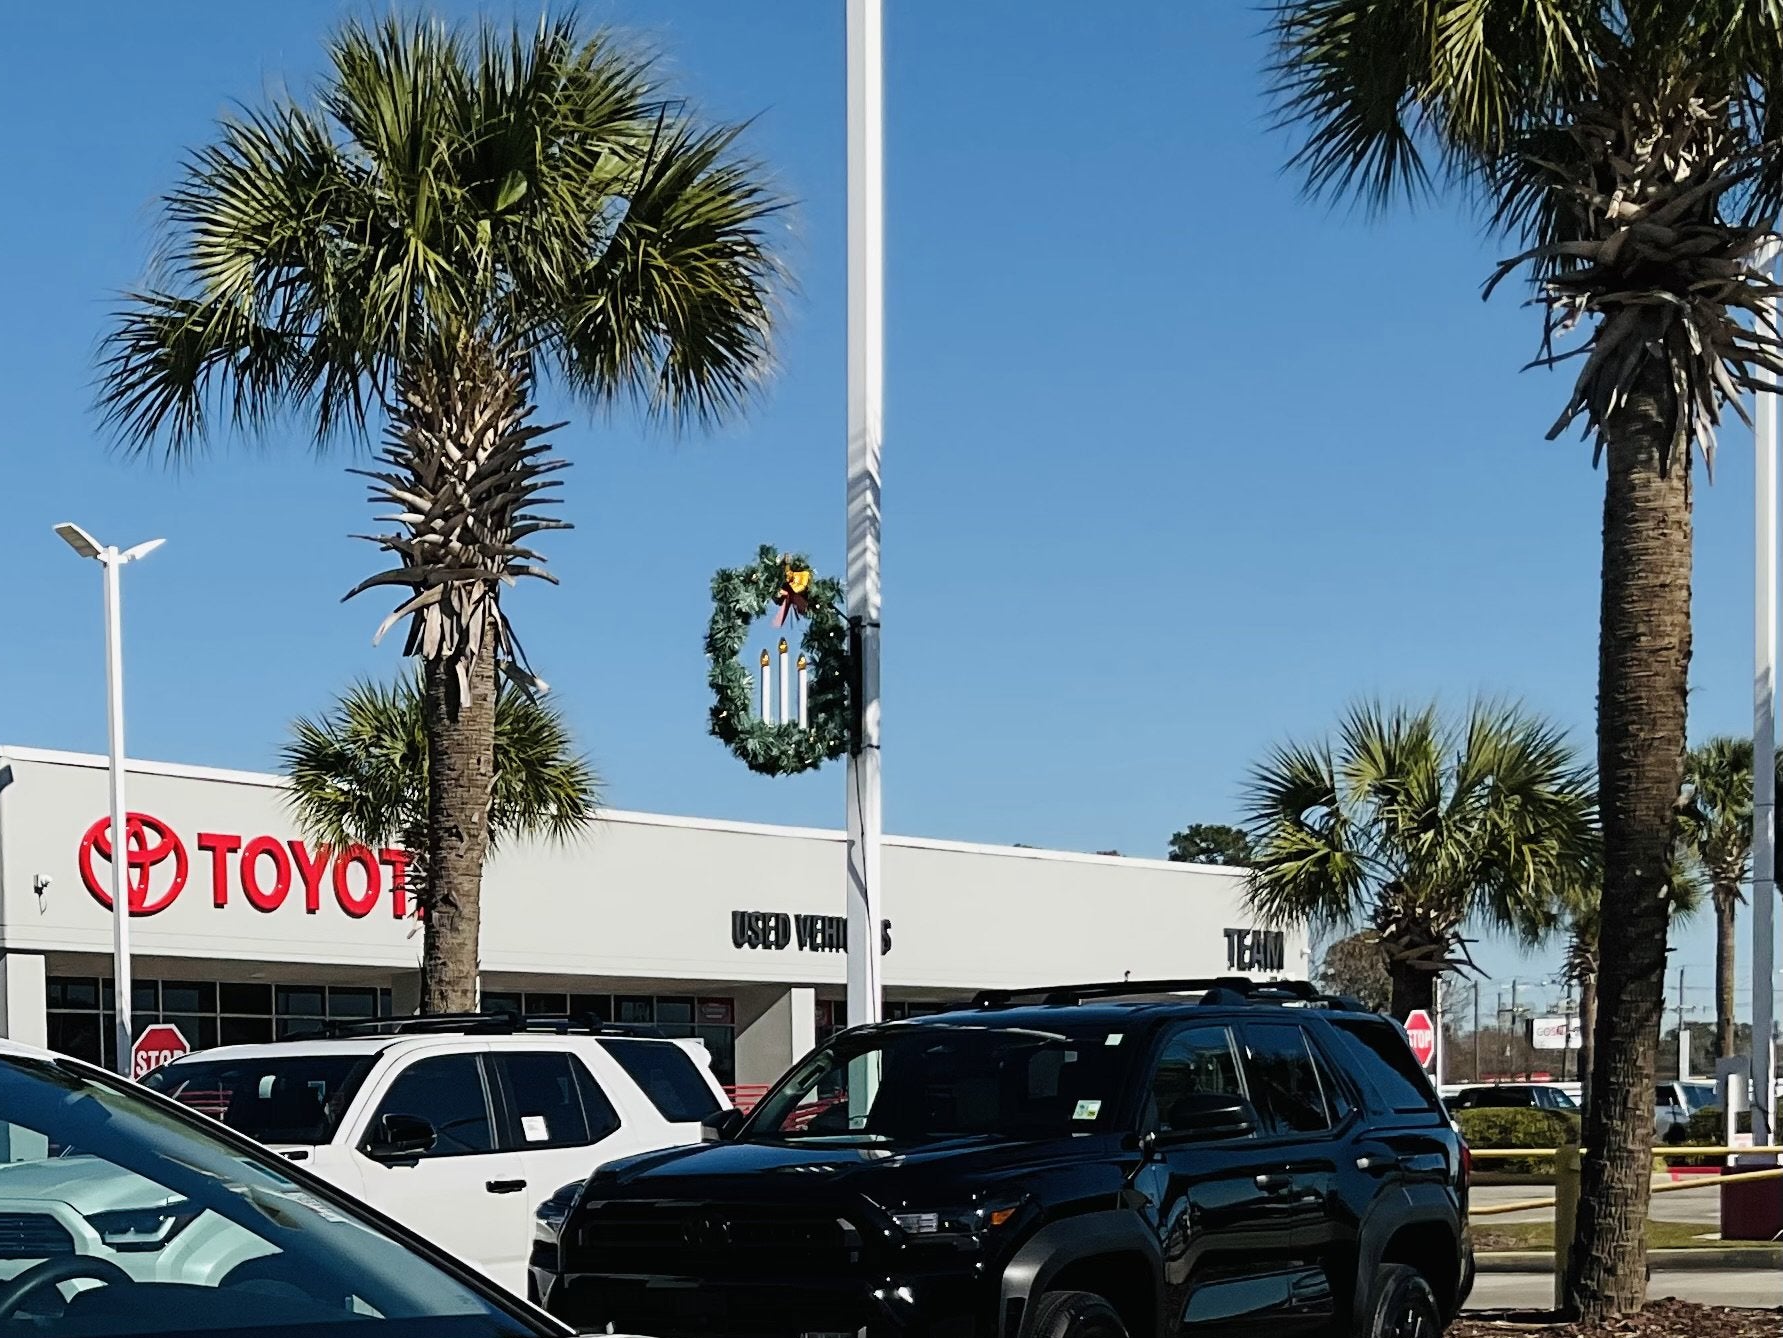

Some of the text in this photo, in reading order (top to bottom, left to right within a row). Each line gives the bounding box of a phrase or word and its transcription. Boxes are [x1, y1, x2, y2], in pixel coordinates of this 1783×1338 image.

[197, 832, 424, 920] TOYOT
[731, 910, 892, 956] USED VEHIS
[1223, 928, 1284, 973] TEAM
